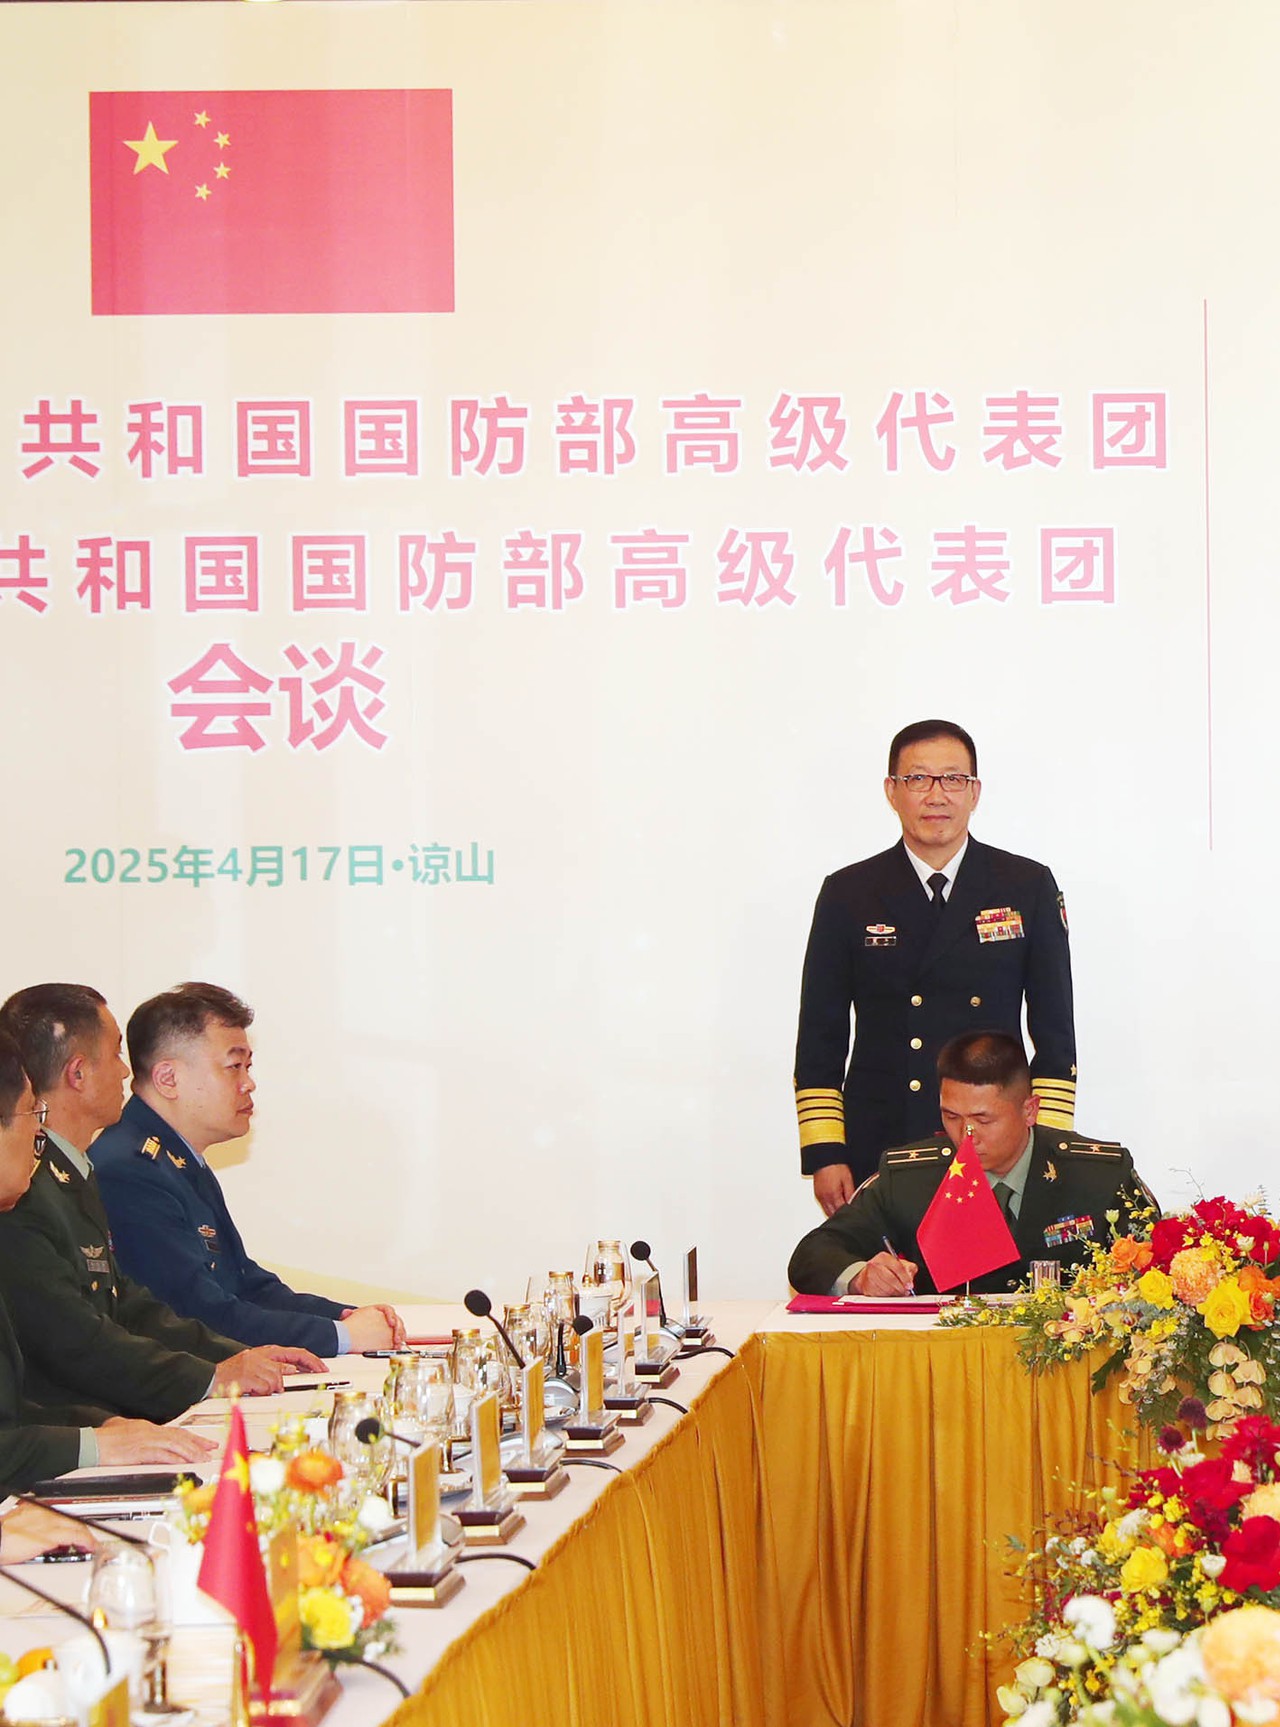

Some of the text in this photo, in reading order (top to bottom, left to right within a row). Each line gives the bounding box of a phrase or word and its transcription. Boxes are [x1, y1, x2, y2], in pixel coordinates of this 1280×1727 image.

[21, 391, 1166, 479] 共和国国防部高级代表团
[168, 643, 387, 752] 会谈
